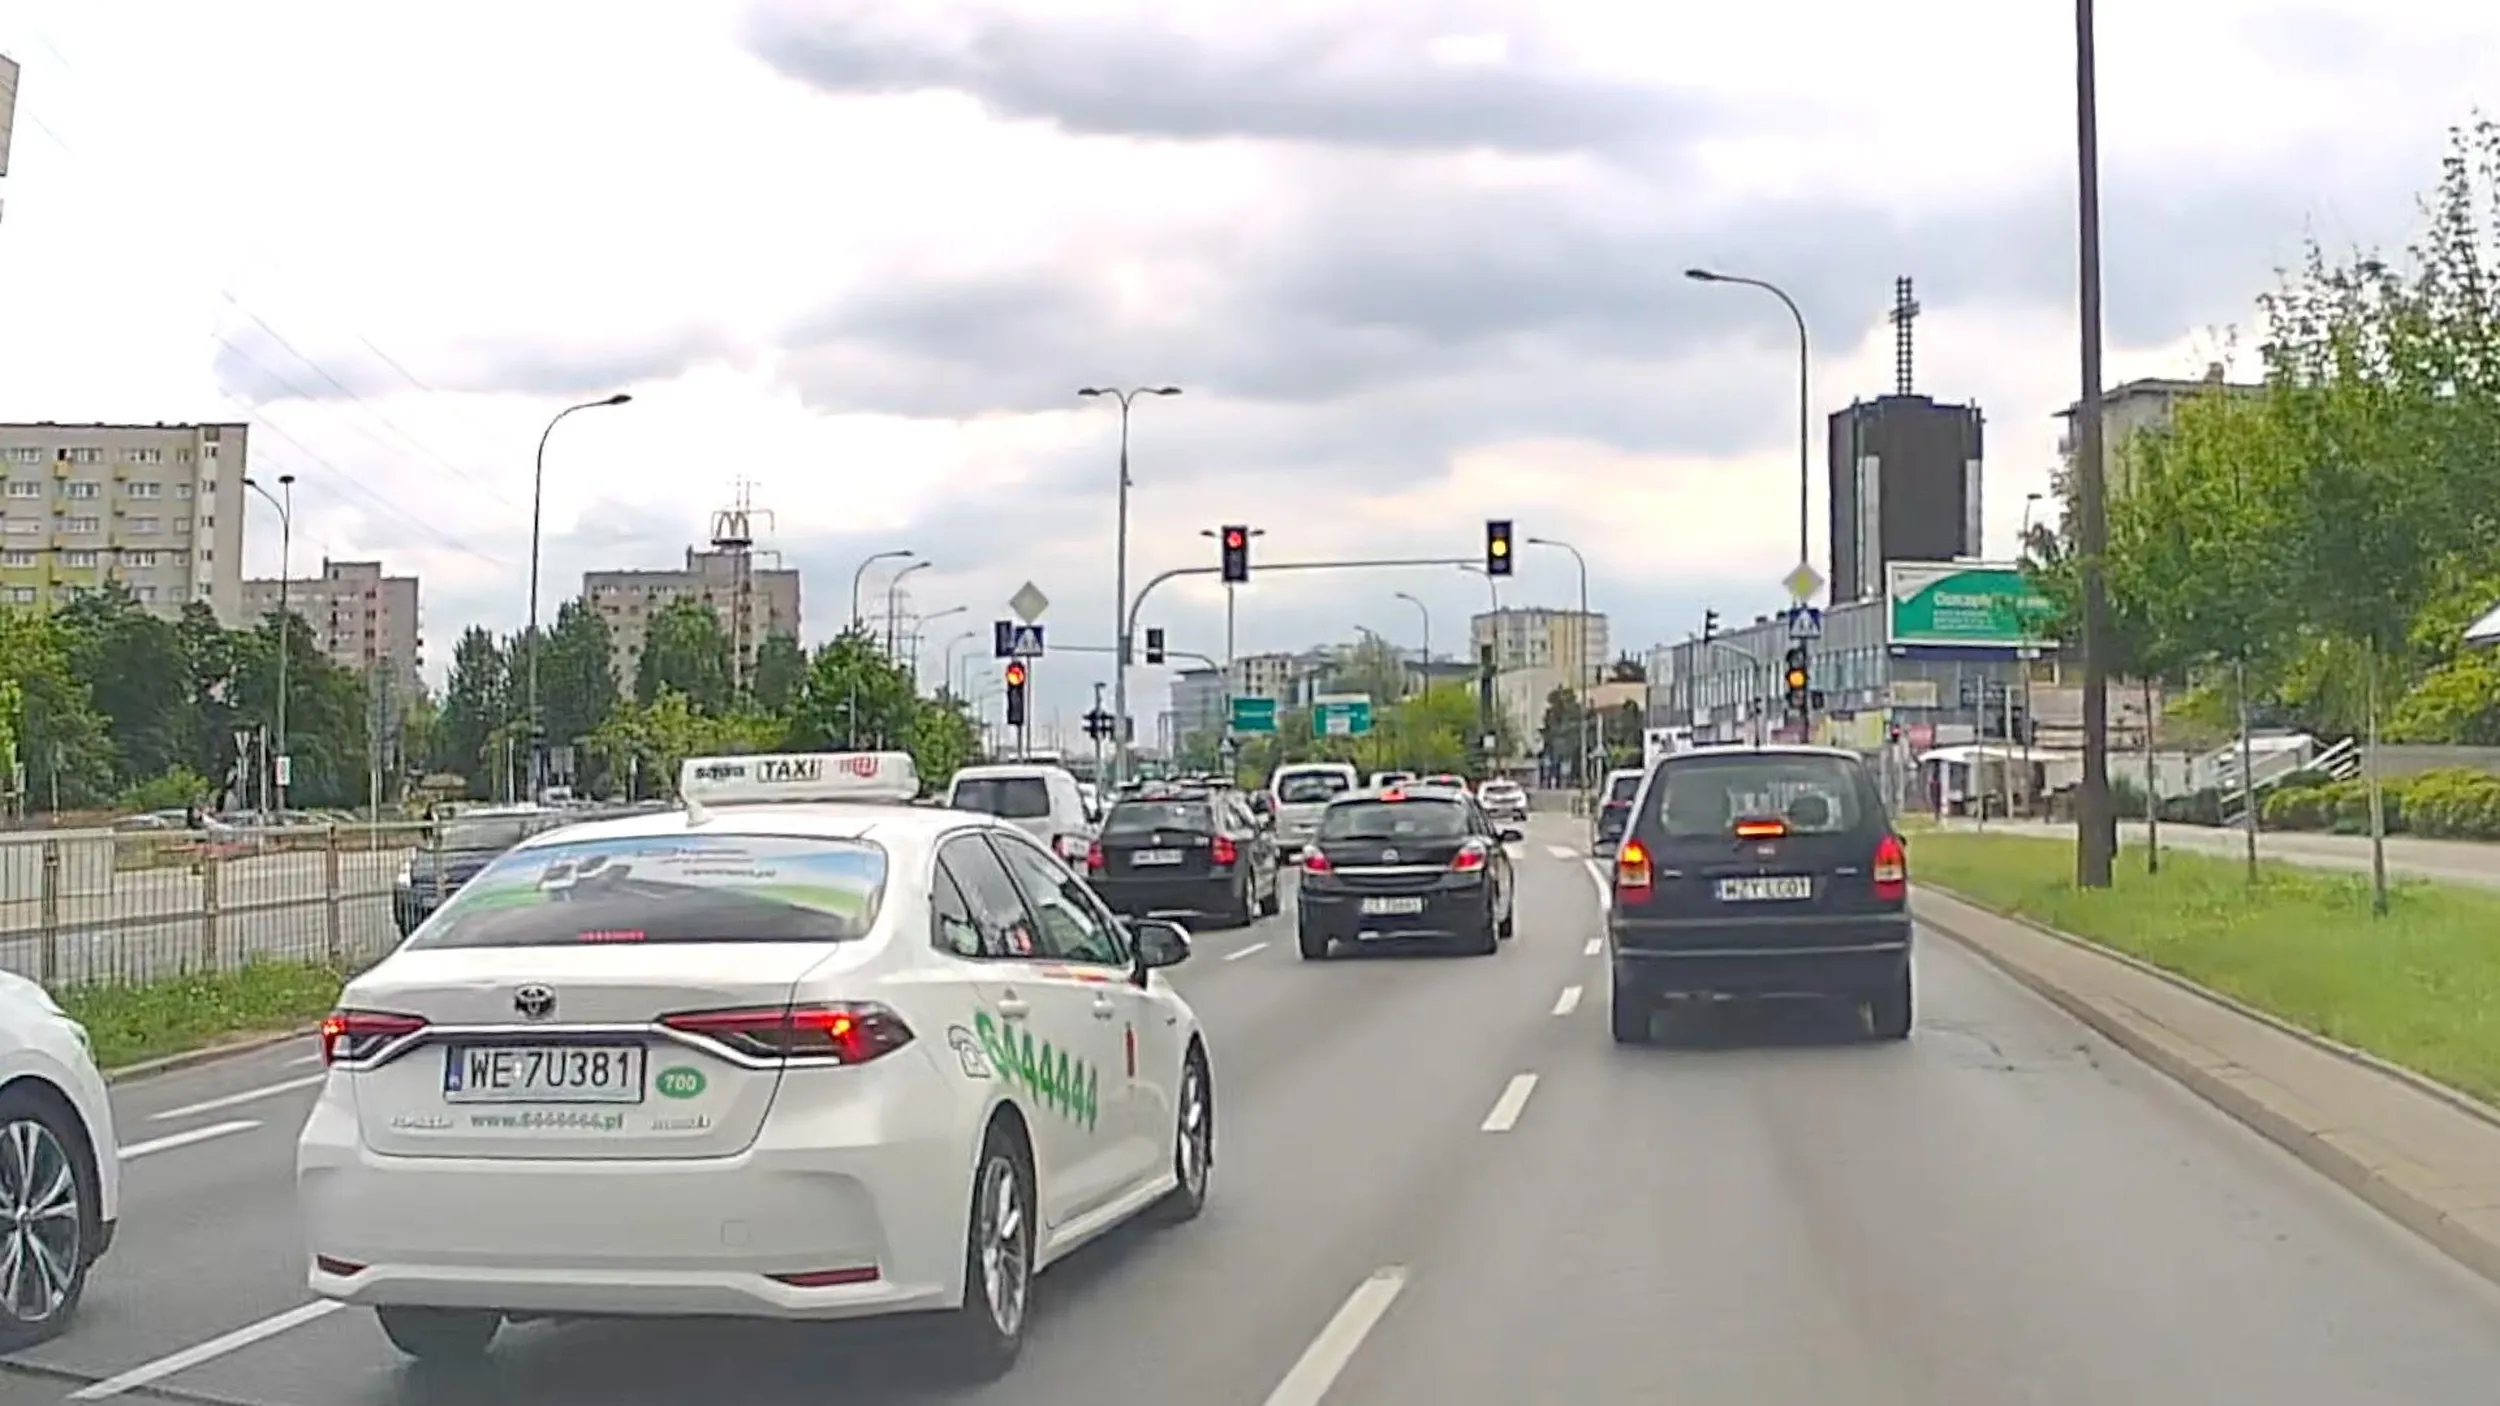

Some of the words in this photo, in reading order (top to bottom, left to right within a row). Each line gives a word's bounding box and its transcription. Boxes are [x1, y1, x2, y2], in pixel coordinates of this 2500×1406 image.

[764, 758, 816, 780] TAXI
[470, 1053, 514, 1088] WE
[524, 1052, 629, 1088] 7U381
[663, 1074, 697, 1092] 700
